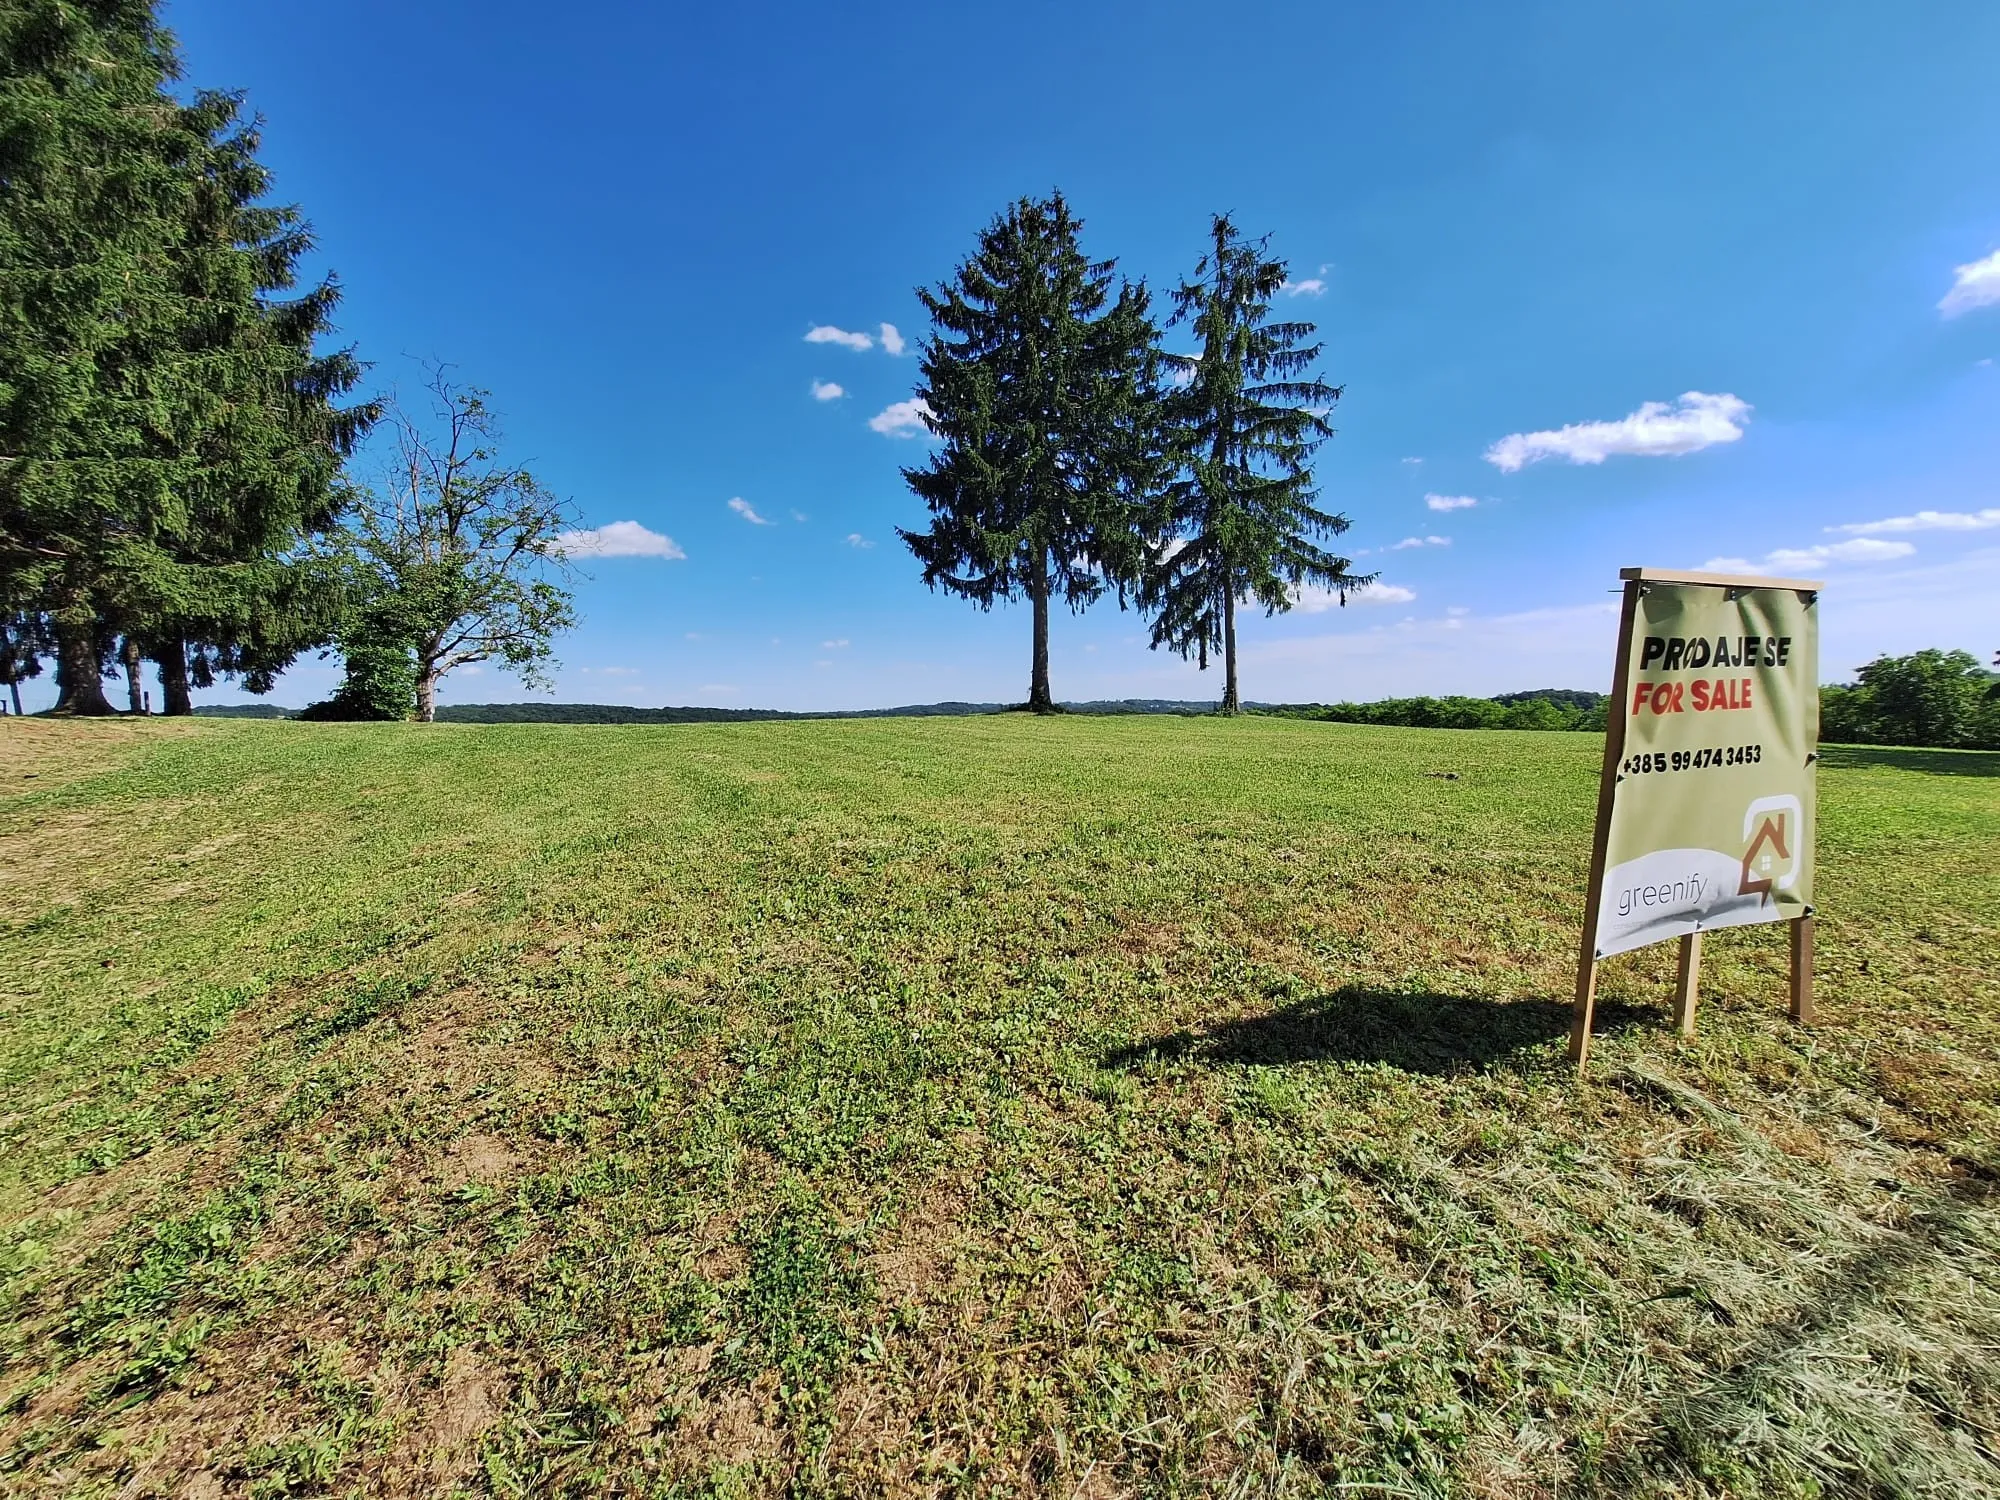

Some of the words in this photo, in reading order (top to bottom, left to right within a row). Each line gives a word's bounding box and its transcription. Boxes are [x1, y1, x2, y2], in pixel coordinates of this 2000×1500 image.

[1640, 636, 1760, 670] PRODAJE
[1764, 637, 1791, 667] SE
[1632, 682, 1684, 716] FOR
[1691, 678, 1752, 712] SALE
[1624, 752, 1666, 774] +385
[1671, 751, 1690, 771] 99
[1693, 748, 1723, 768] 474
[1726, 745, 1761, 766] 3453
[1618, 873, 1708, 916] greenify
